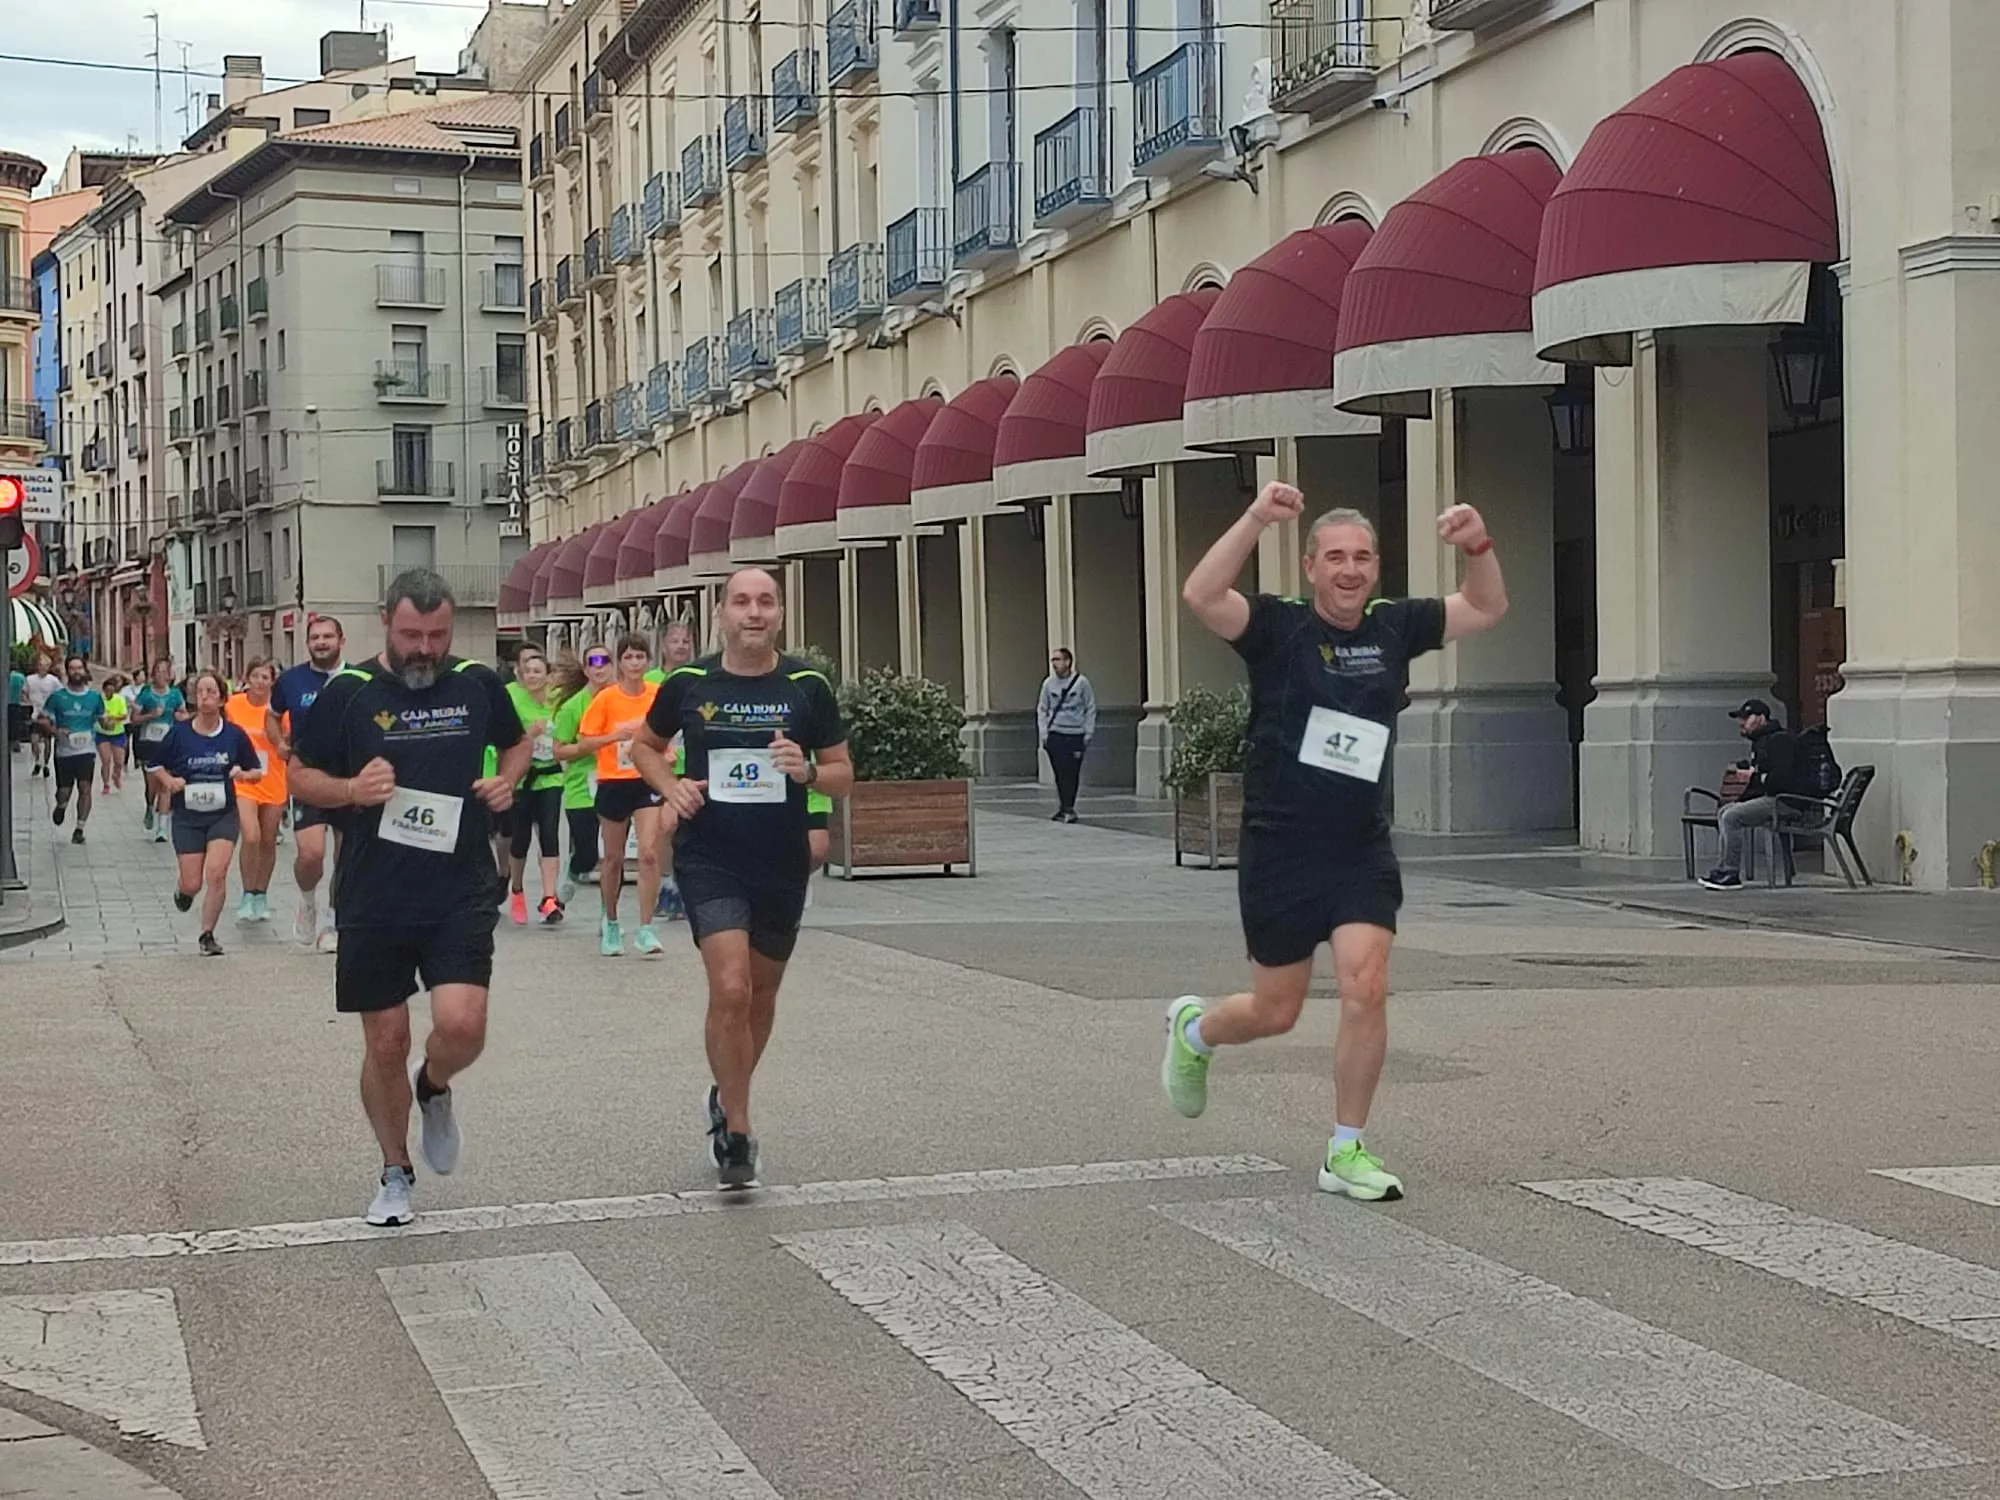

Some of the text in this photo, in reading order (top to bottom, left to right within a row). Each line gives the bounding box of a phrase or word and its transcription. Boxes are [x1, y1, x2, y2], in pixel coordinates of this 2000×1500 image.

[507, 423, 521, 518] HOSTAL
[400, 704, 469, 721] CAJA RURAL
[723, 703, 752, 714] CAJA
[1325, 731, 1359, 753] 47
[729, 762, 759, 781] 48
[403, 805, 436, 827] 46
